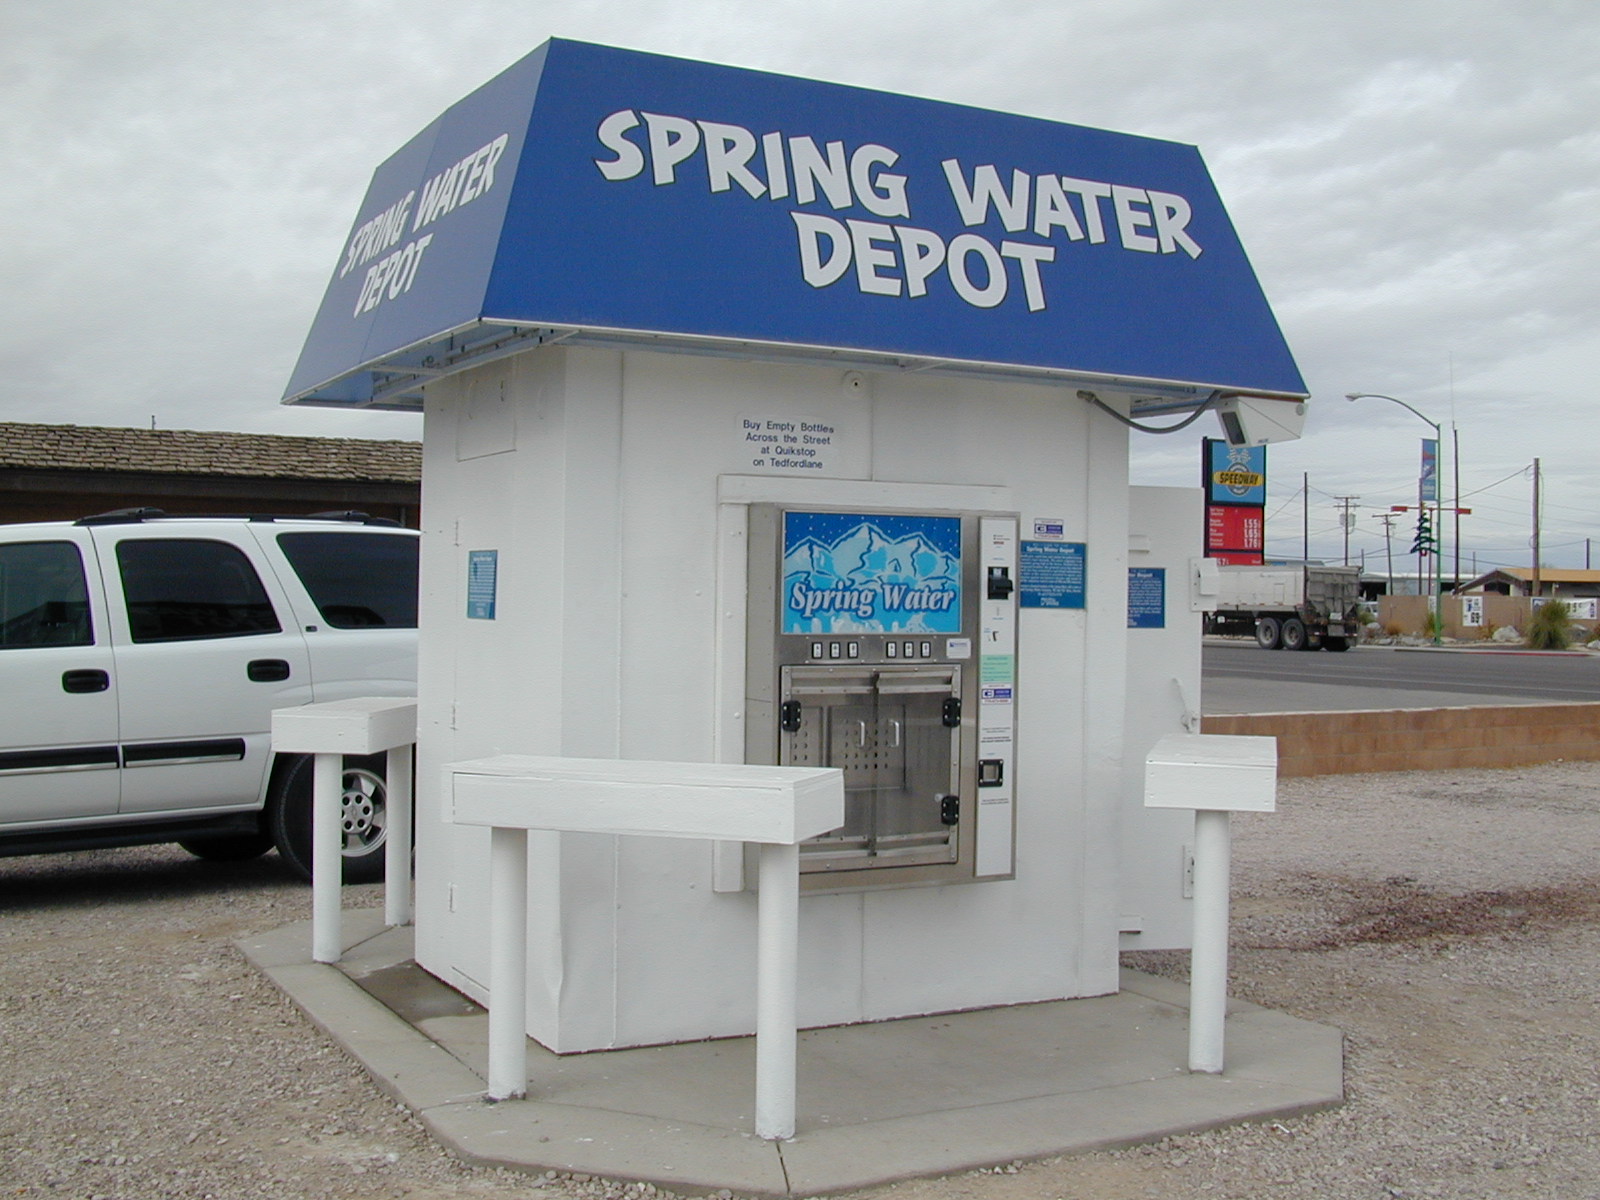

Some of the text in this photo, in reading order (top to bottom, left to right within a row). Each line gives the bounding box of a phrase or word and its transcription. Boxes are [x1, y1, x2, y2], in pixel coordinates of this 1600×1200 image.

[594, 109, 1203, 260] SPRING WATER
[340, 133, 508, 279] SPRING WATER
[789, 210, 1056, 312] DEPOT
[353, 233, 434, 318] DEPOT
[743, 419, 834, 433] Buy Empty Bottles
[745, 432, 831, 444] Across the Street
[753, 459, 764, 467] on
[761, 445, 816, 457] at Quikstop
[1219, 472, 1259, 486] SPEEDWAY
[791, 580, 955, 617] Spring Water
